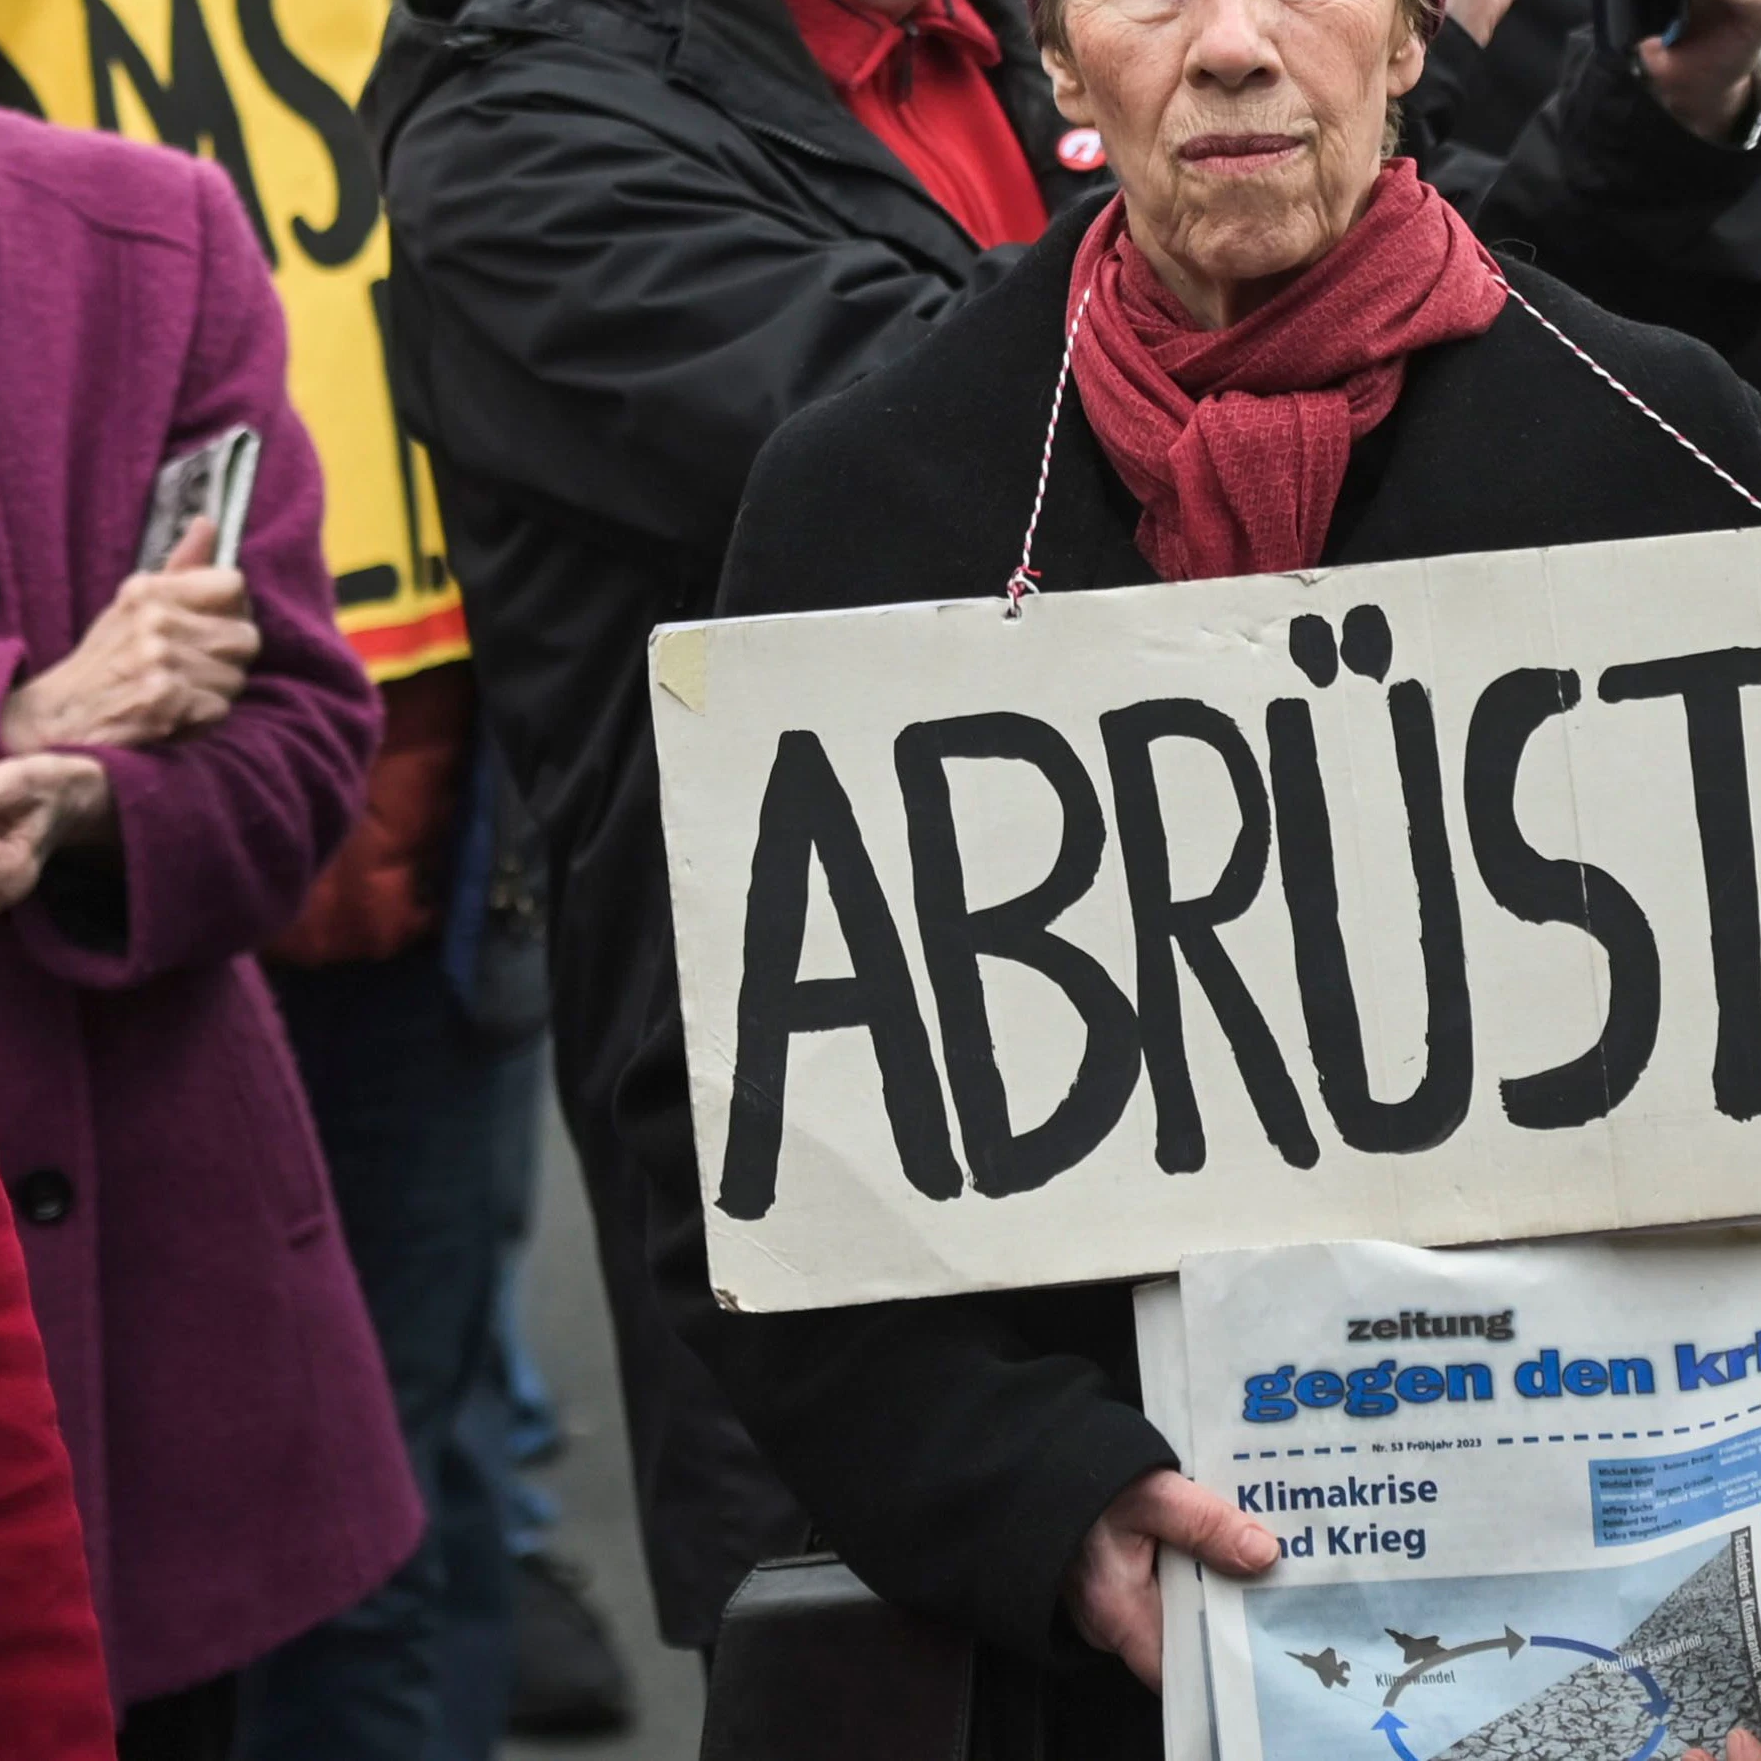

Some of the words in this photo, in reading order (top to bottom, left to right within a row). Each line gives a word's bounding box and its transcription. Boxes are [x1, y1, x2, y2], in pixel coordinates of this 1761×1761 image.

[1347, 1308, 1515, 1343] zeitung
[1242, 1359, 1494, 1424] gegen
[1514, 1349, 1656, 1400] den
[1371, 1443, 1388, 1453] Nr.
[1391, 1441, 1404, 1452] 53
[1406, 1439, 1453, 1451] Frühjahr
[1456, 1438, 1482, 1449] 2023
[1237, 1474, 1438, 1514] Klimakrise
[1327, 1523, 1427, 1559] Krieg
[1735, 1530, 1754, 1598] Teufelskreis
[1596, 1634, 1704, 1674] Konflikt-Eskalation
